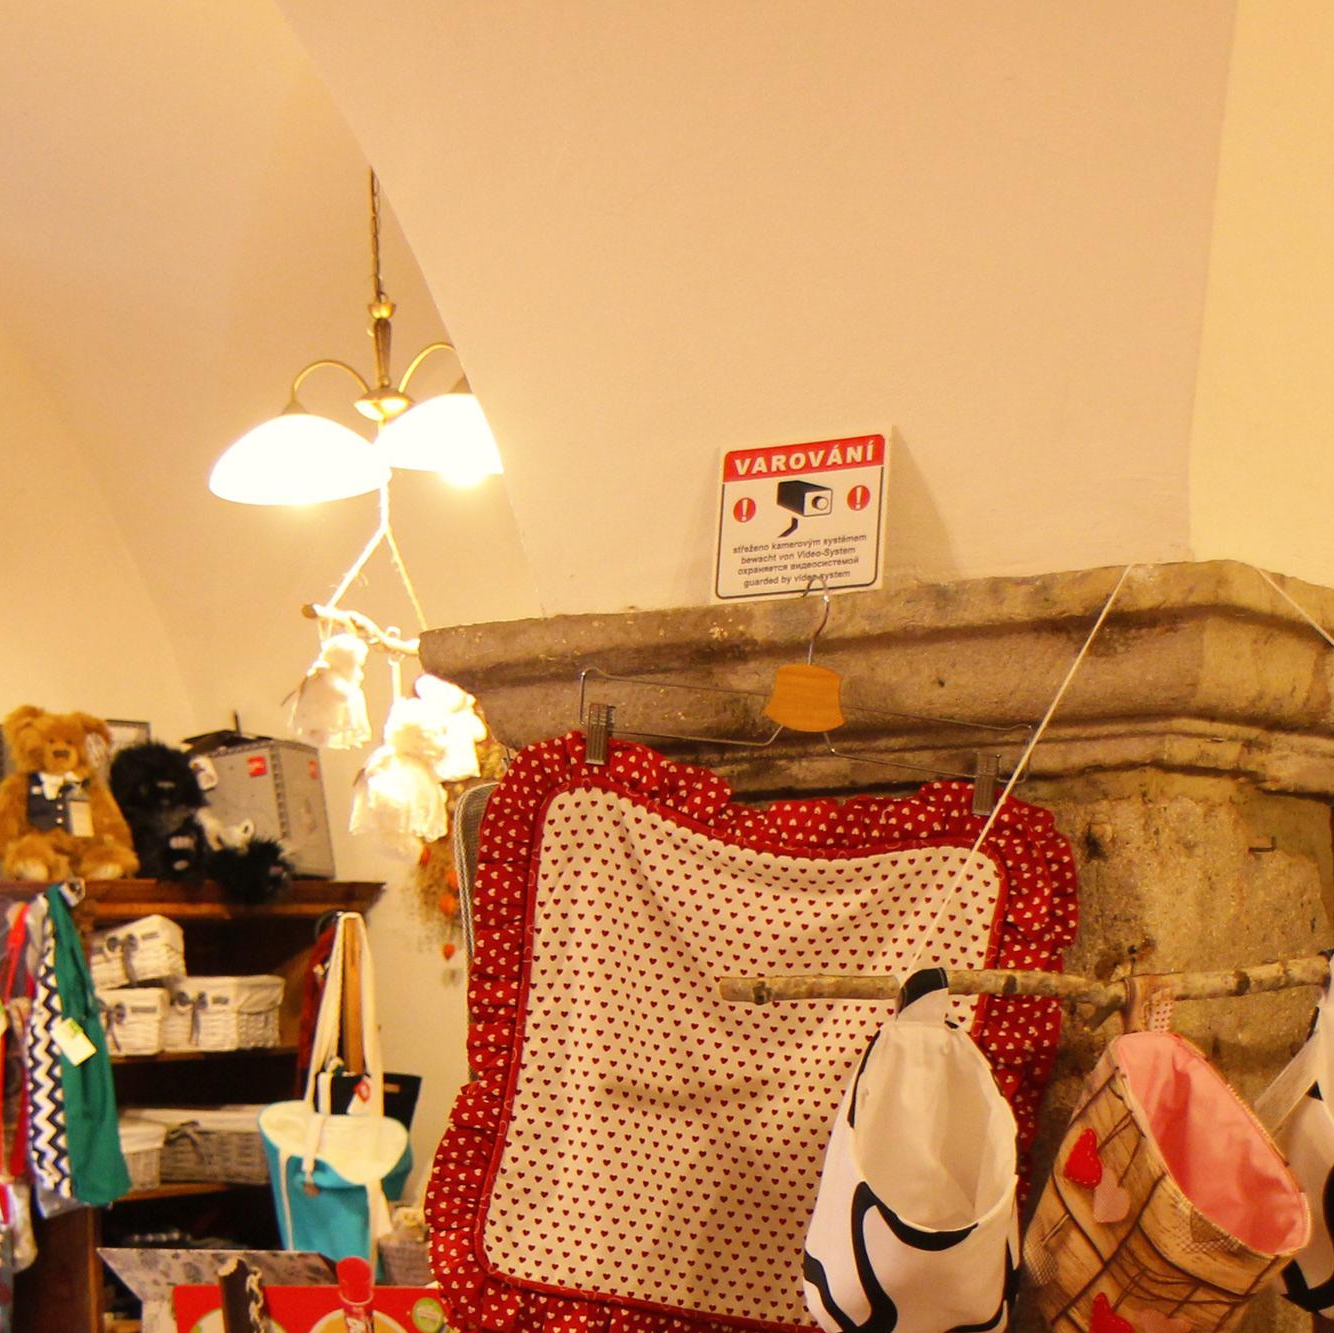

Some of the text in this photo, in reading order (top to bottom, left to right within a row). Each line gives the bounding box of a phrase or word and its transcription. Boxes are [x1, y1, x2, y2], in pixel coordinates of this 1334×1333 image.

[734, 440, 875, 476] VAROVÁNÍ
[771, 539, 821, 551] kamerovým
[823, 534, 867, 546] systémem
[741, 554, 777, 565] bewacht
[778, 553, 795, 561] von
[737, 563, 788, 576] охраняется
[743, 577, 779, 589] guarded
[781, 574, 791, 584] by
